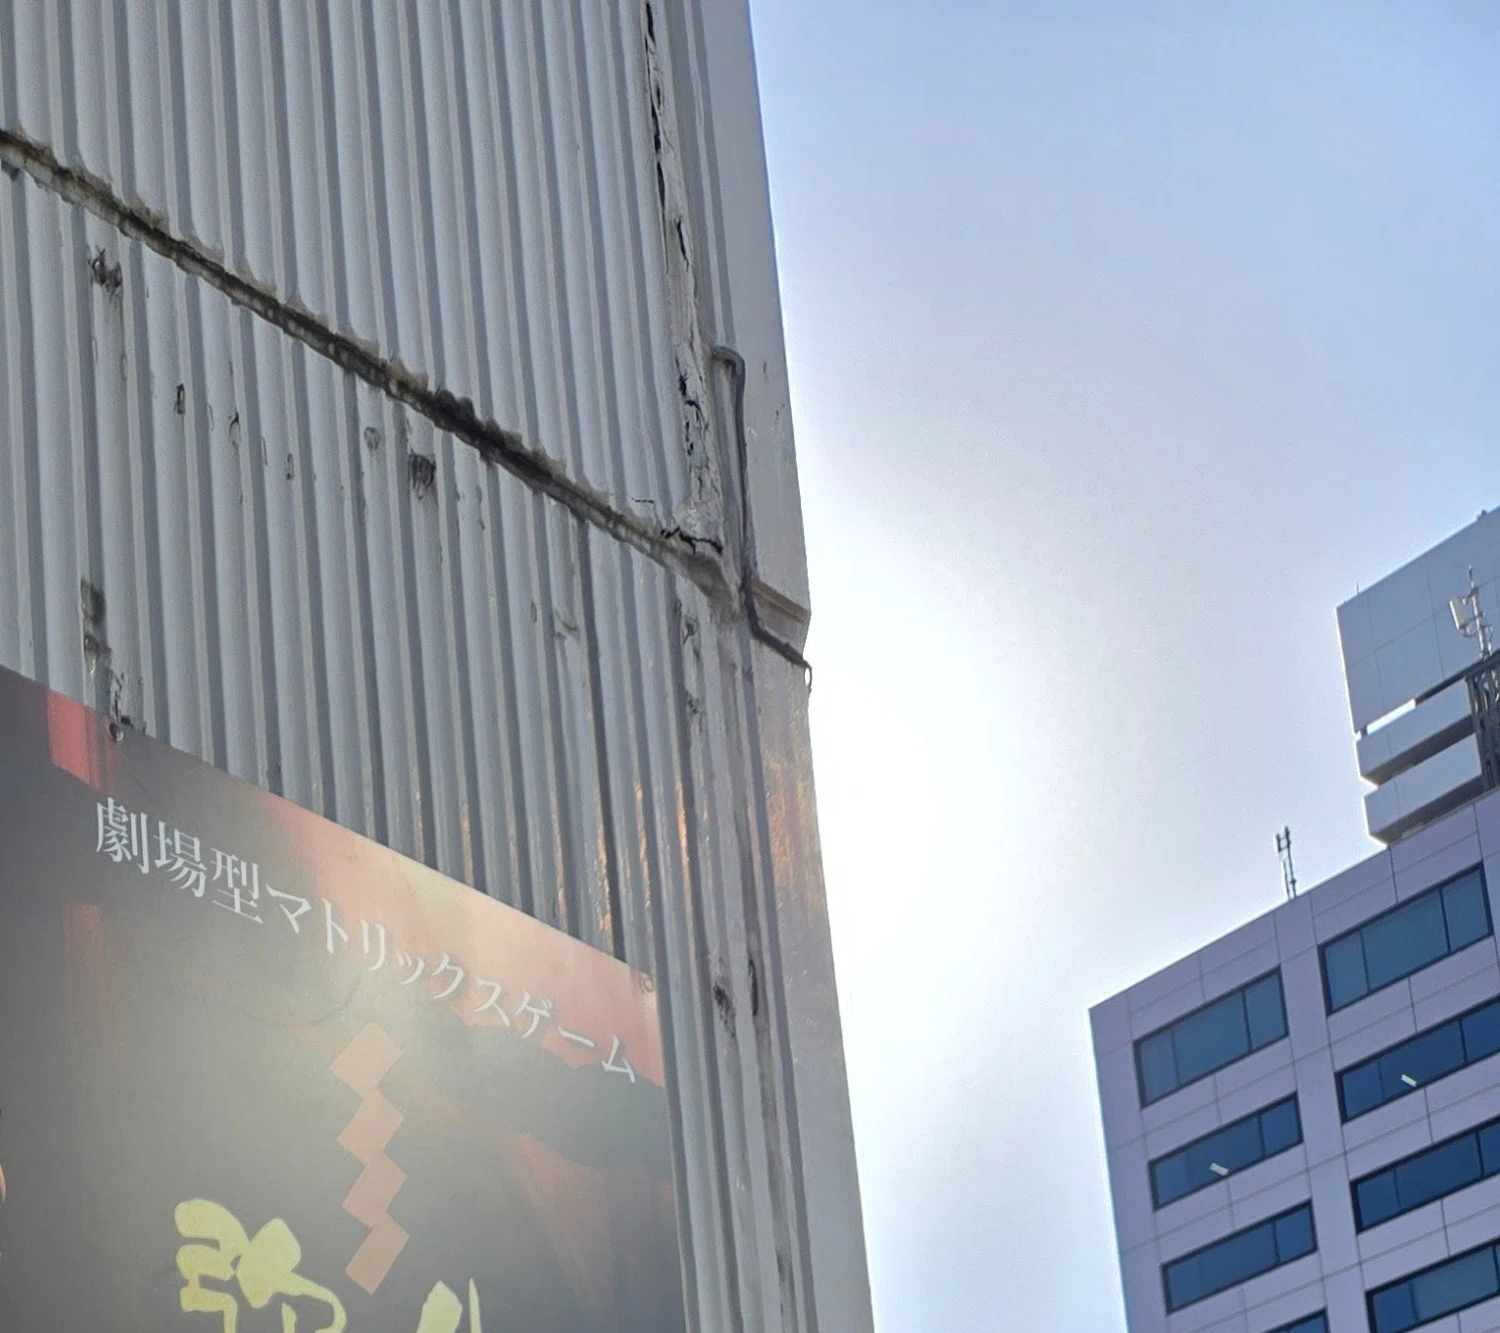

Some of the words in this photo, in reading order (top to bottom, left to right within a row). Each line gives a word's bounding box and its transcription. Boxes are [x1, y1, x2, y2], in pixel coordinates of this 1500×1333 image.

[95, 797, 637, 1084] 劇場型マトリックスゲーム
